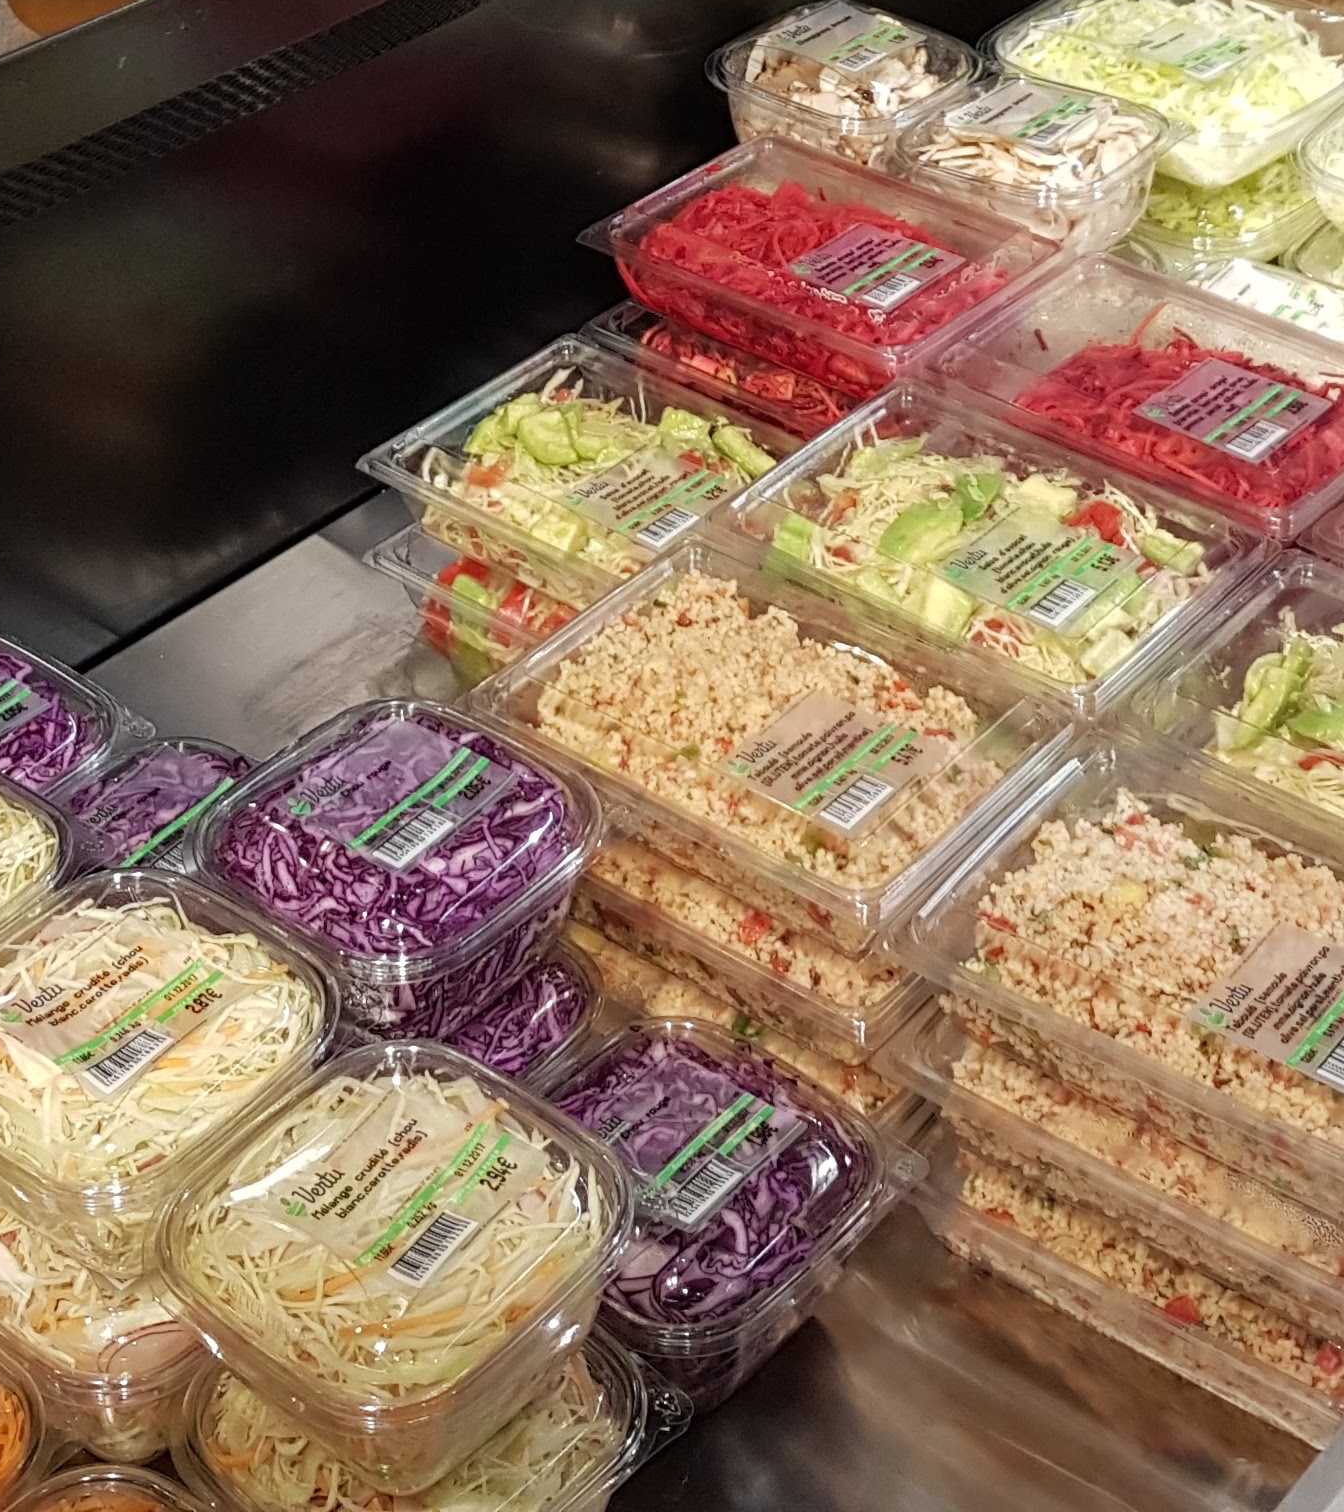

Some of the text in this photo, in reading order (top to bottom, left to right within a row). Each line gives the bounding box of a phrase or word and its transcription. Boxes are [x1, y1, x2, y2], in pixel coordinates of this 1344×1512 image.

[300, 775, 346, 803] Vertu
[86, 804, 118, 828] ertu
[12, 984, 66, 1014] Vertu
[25, 1000, 70, 1027] Mélange
[73, 970, 110, 999] crudité
[1209, 983, 1254, 1014] Vertu
[292, 1168, 345, 1204] Vertu
[311, 1185, 354, 1220] Mélange
[354, 1147, 389, 1182] crudité
